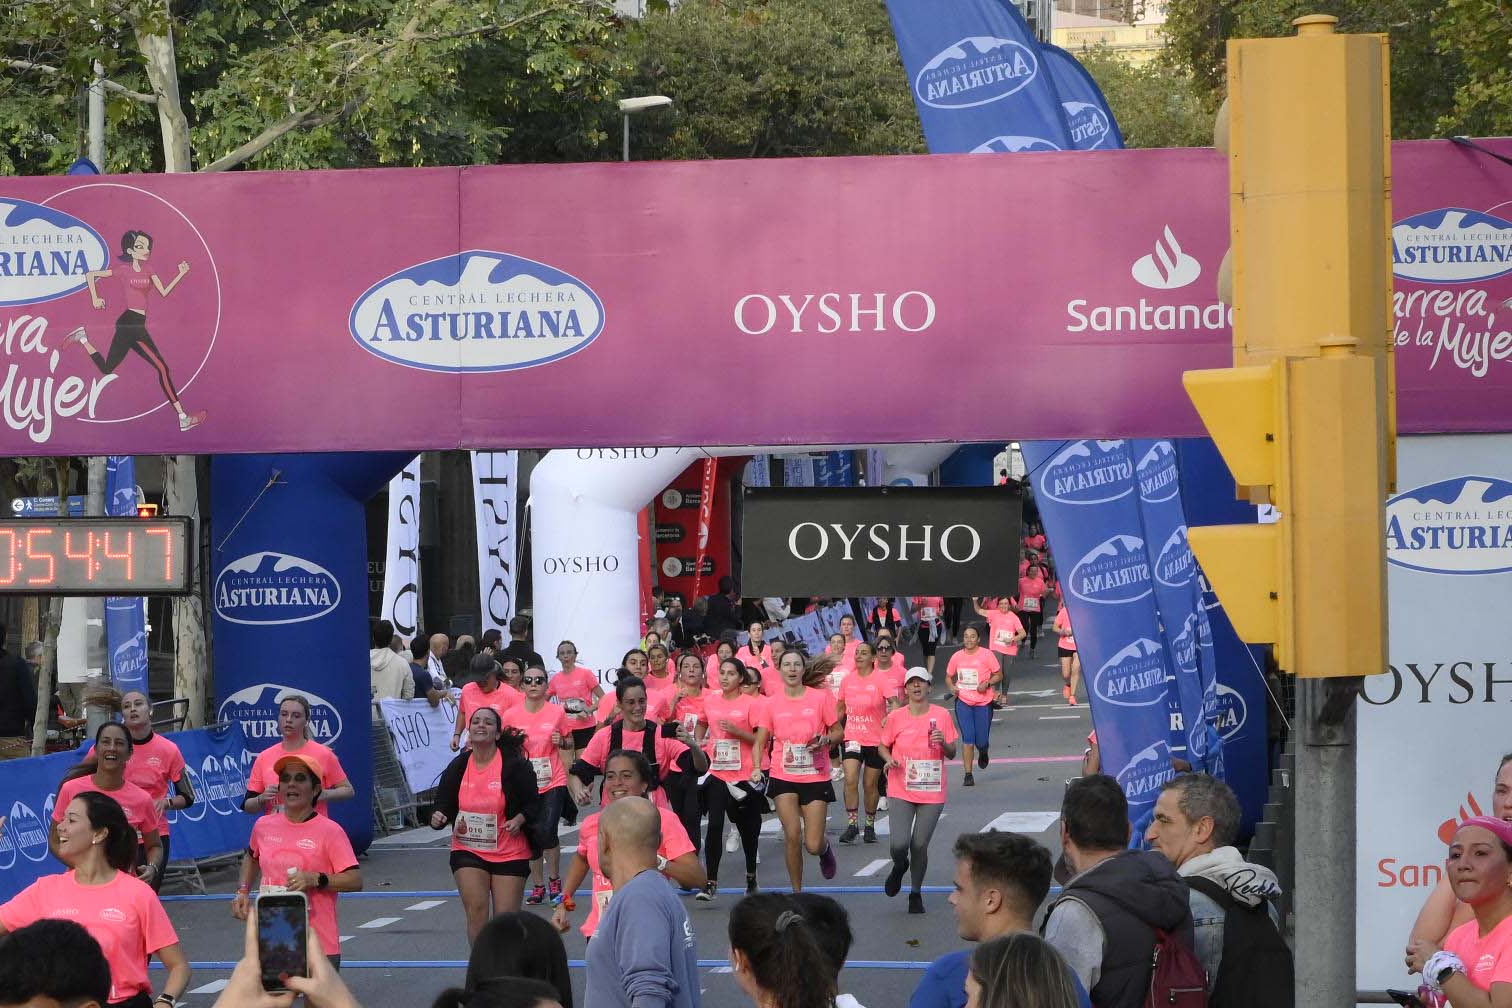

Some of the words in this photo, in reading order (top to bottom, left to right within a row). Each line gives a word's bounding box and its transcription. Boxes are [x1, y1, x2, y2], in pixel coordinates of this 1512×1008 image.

[11, 234, 84, 245] LECHERA
[1406, 234, 1458, 242] CENTRAL
[408, 293, 487, 306] CENTRAL
[495, 291, 576, 304] LECHERA
[369, 298, 585, 342] ASTURIANA
[734, 291, 937, 335] OYSHO
[1067, 299, 1236, 334] Santand
[1415, 319, 1434, 346] la
[1413, 511, 1480, 521] CENTRAL
[787, 521, 982, 564] OYSHO
[543, 555, 620, 575] OYSHO
[231, 577, 274, 586] CENTRAL
[278, 576, 327, 585] LECHERA
[218, 580, 332, 609] ASTURIANA
[232, 709, 274, 718] CENTRAL
